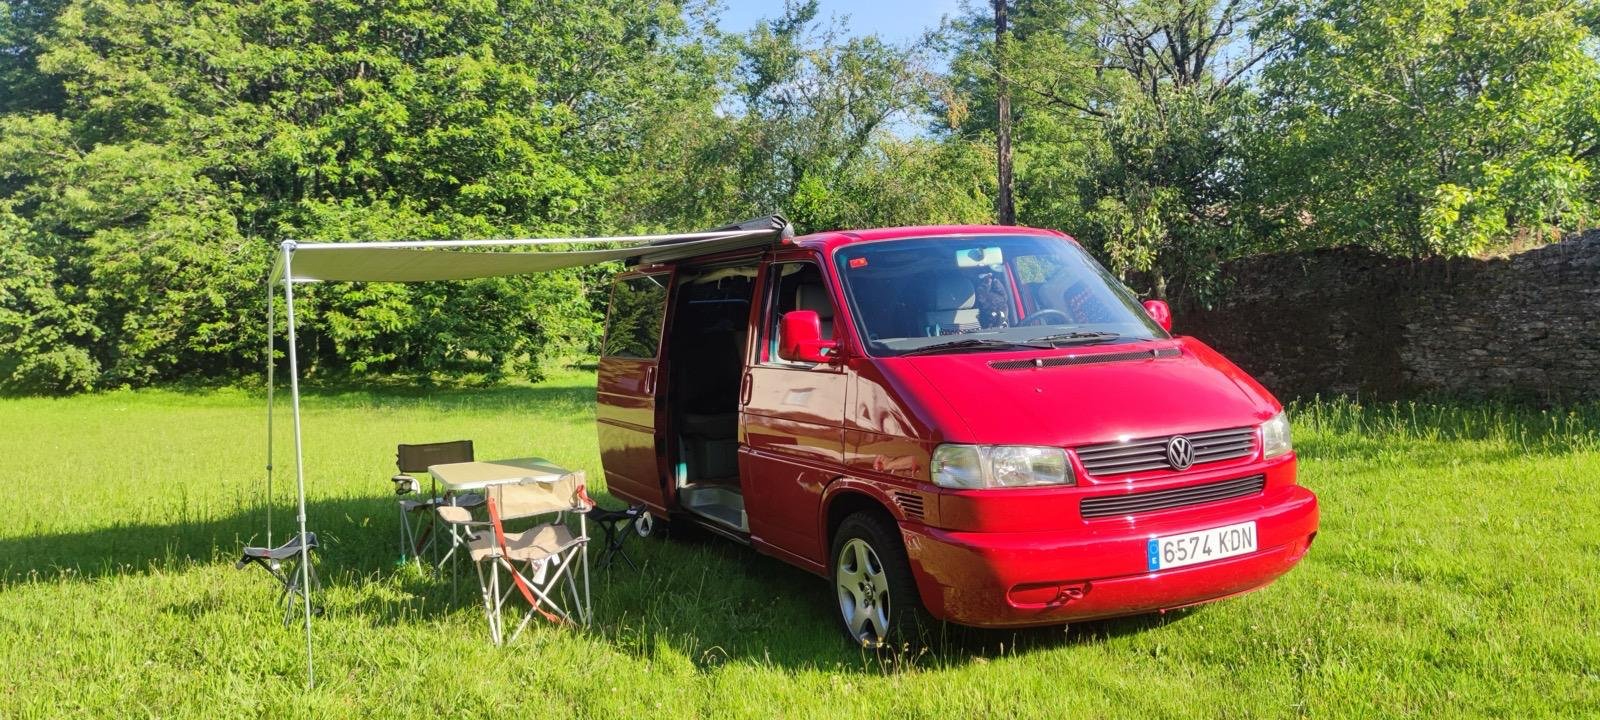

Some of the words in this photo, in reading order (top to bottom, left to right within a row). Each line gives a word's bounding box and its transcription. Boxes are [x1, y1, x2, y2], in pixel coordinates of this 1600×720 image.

[1168, 436, 1194, 470] VW
[1163, 535, 1212, 563] 6574
[1219, 526, 1252, 553] KDN
